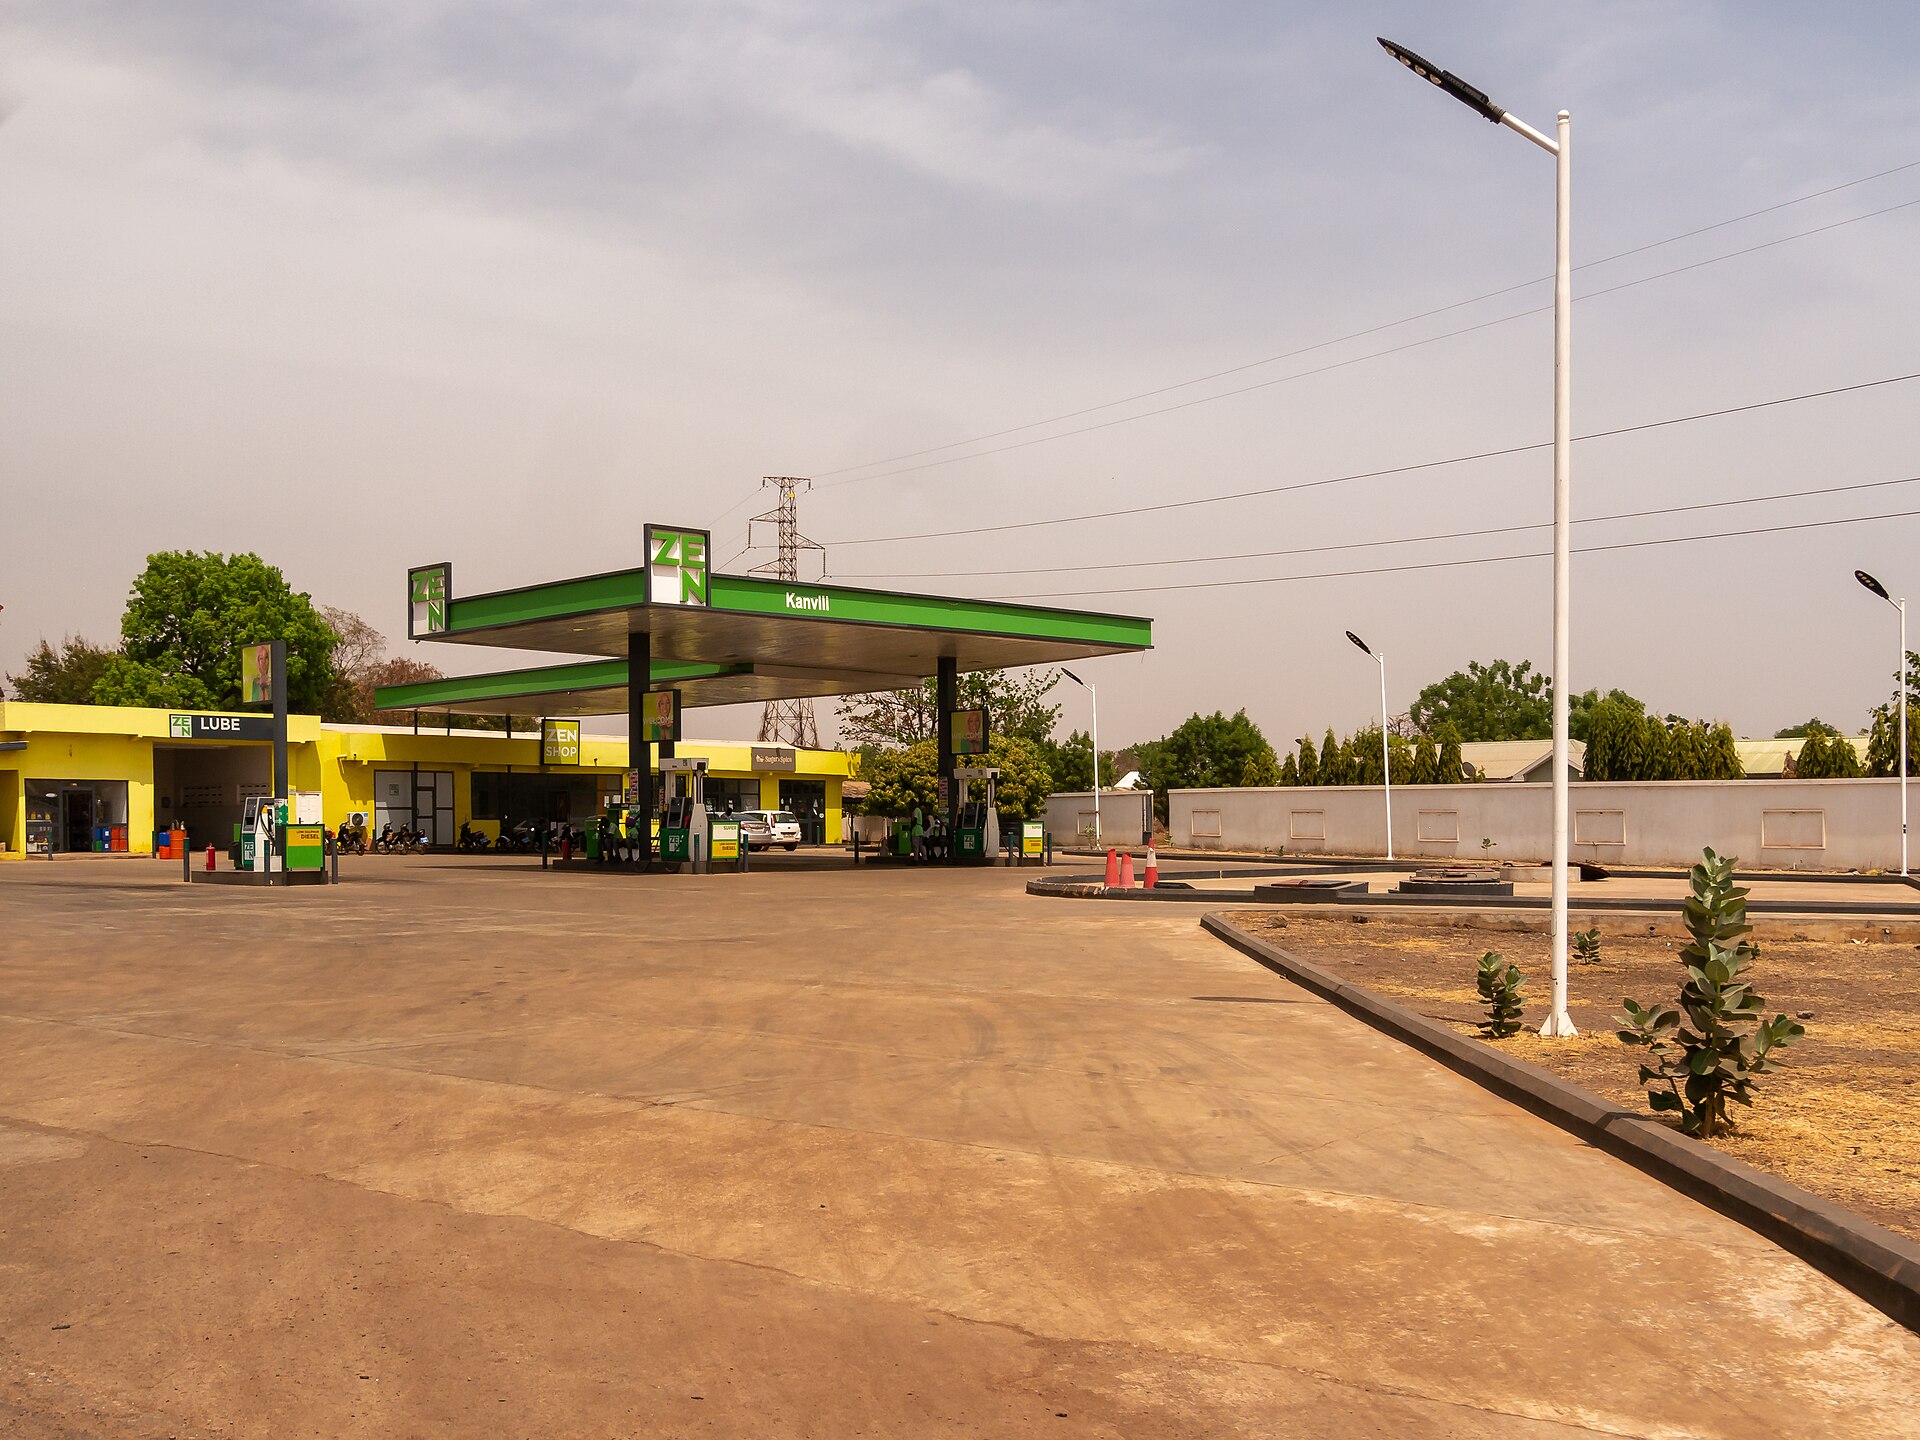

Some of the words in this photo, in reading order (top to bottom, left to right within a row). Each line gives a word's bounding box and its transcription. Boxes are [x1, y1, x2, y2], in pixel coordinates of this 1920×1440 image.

[200, 717, 241, 731] LUBE
[546, 728, 577, 742] ZEN
[546, 746, 577, 757] SHOP
